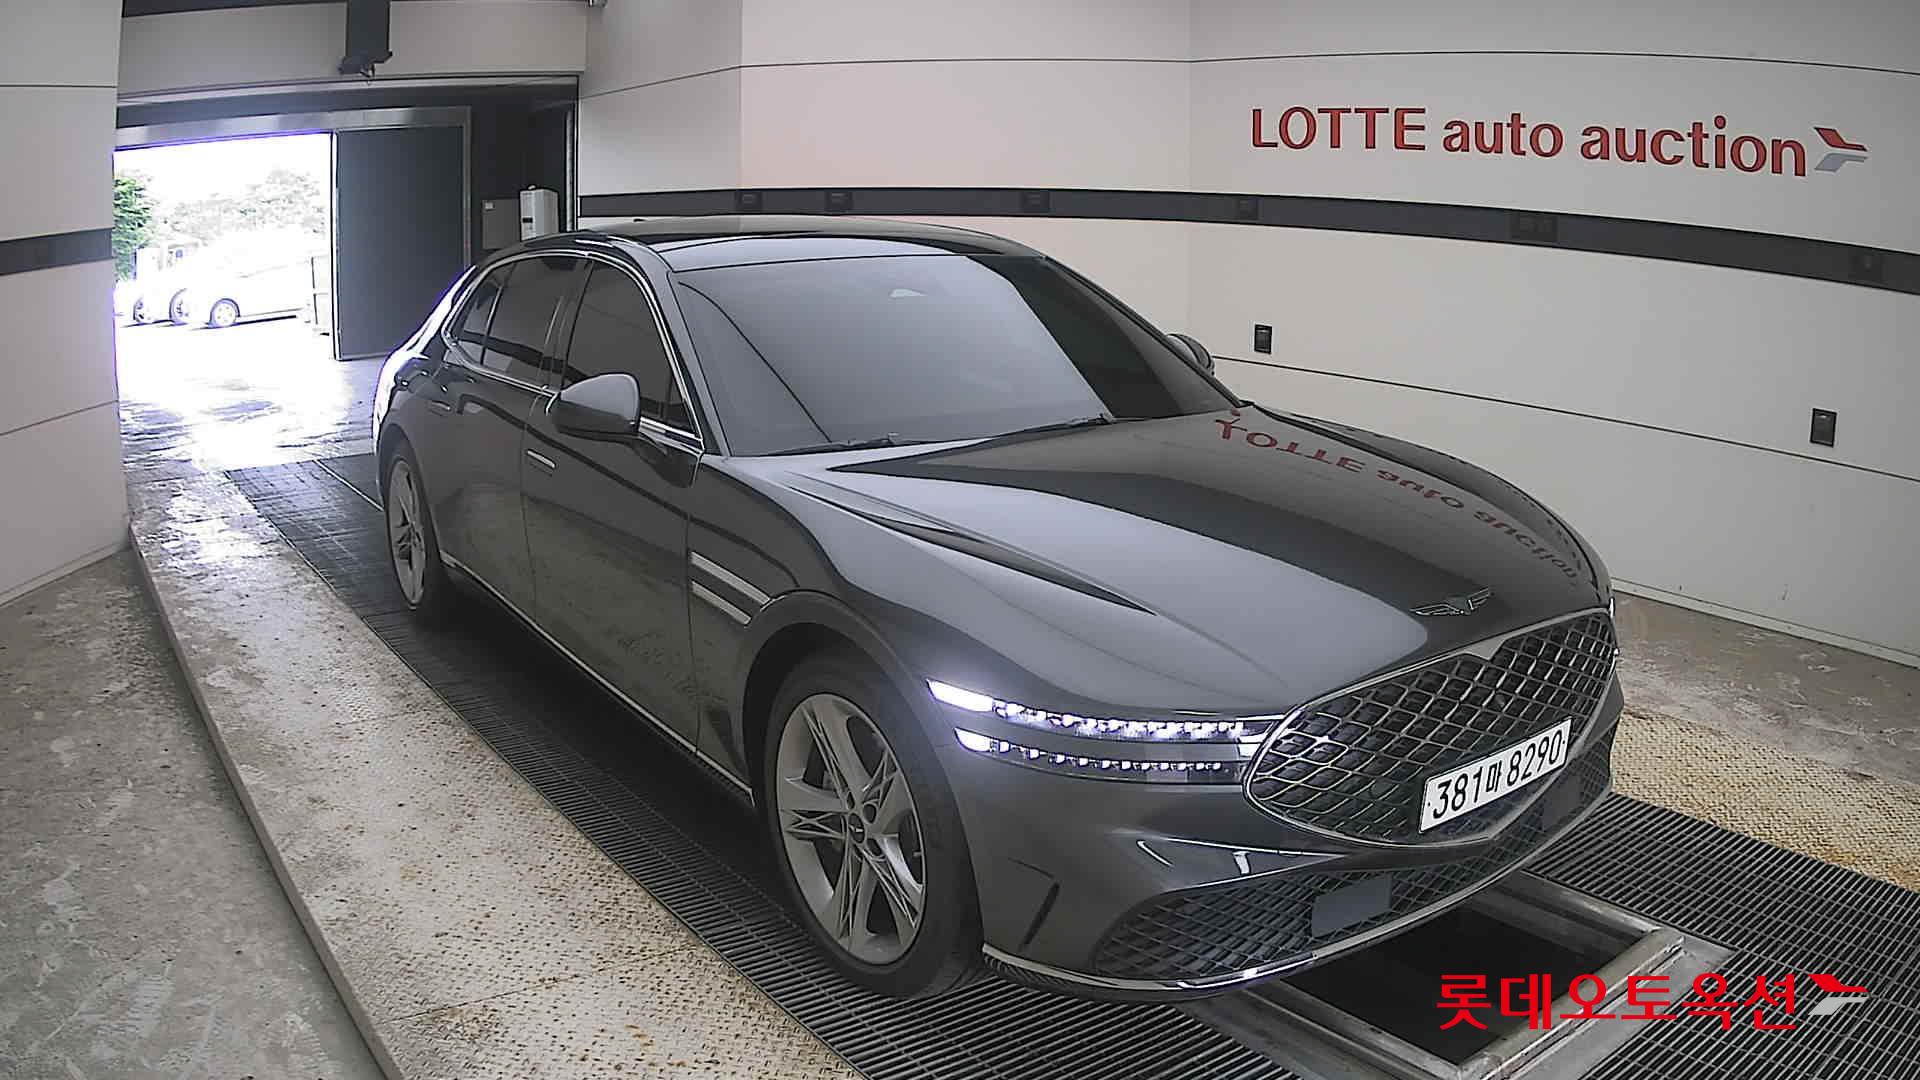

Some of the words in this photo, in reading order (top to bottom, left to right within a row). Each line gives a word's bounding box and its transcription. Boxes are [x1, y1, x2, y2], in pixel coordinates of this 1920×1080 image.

[1251, 106, 1426, 151] LOTTE
[1442, 113, 1564, 158] auto
[1580, 115, 1807, 177] auction
